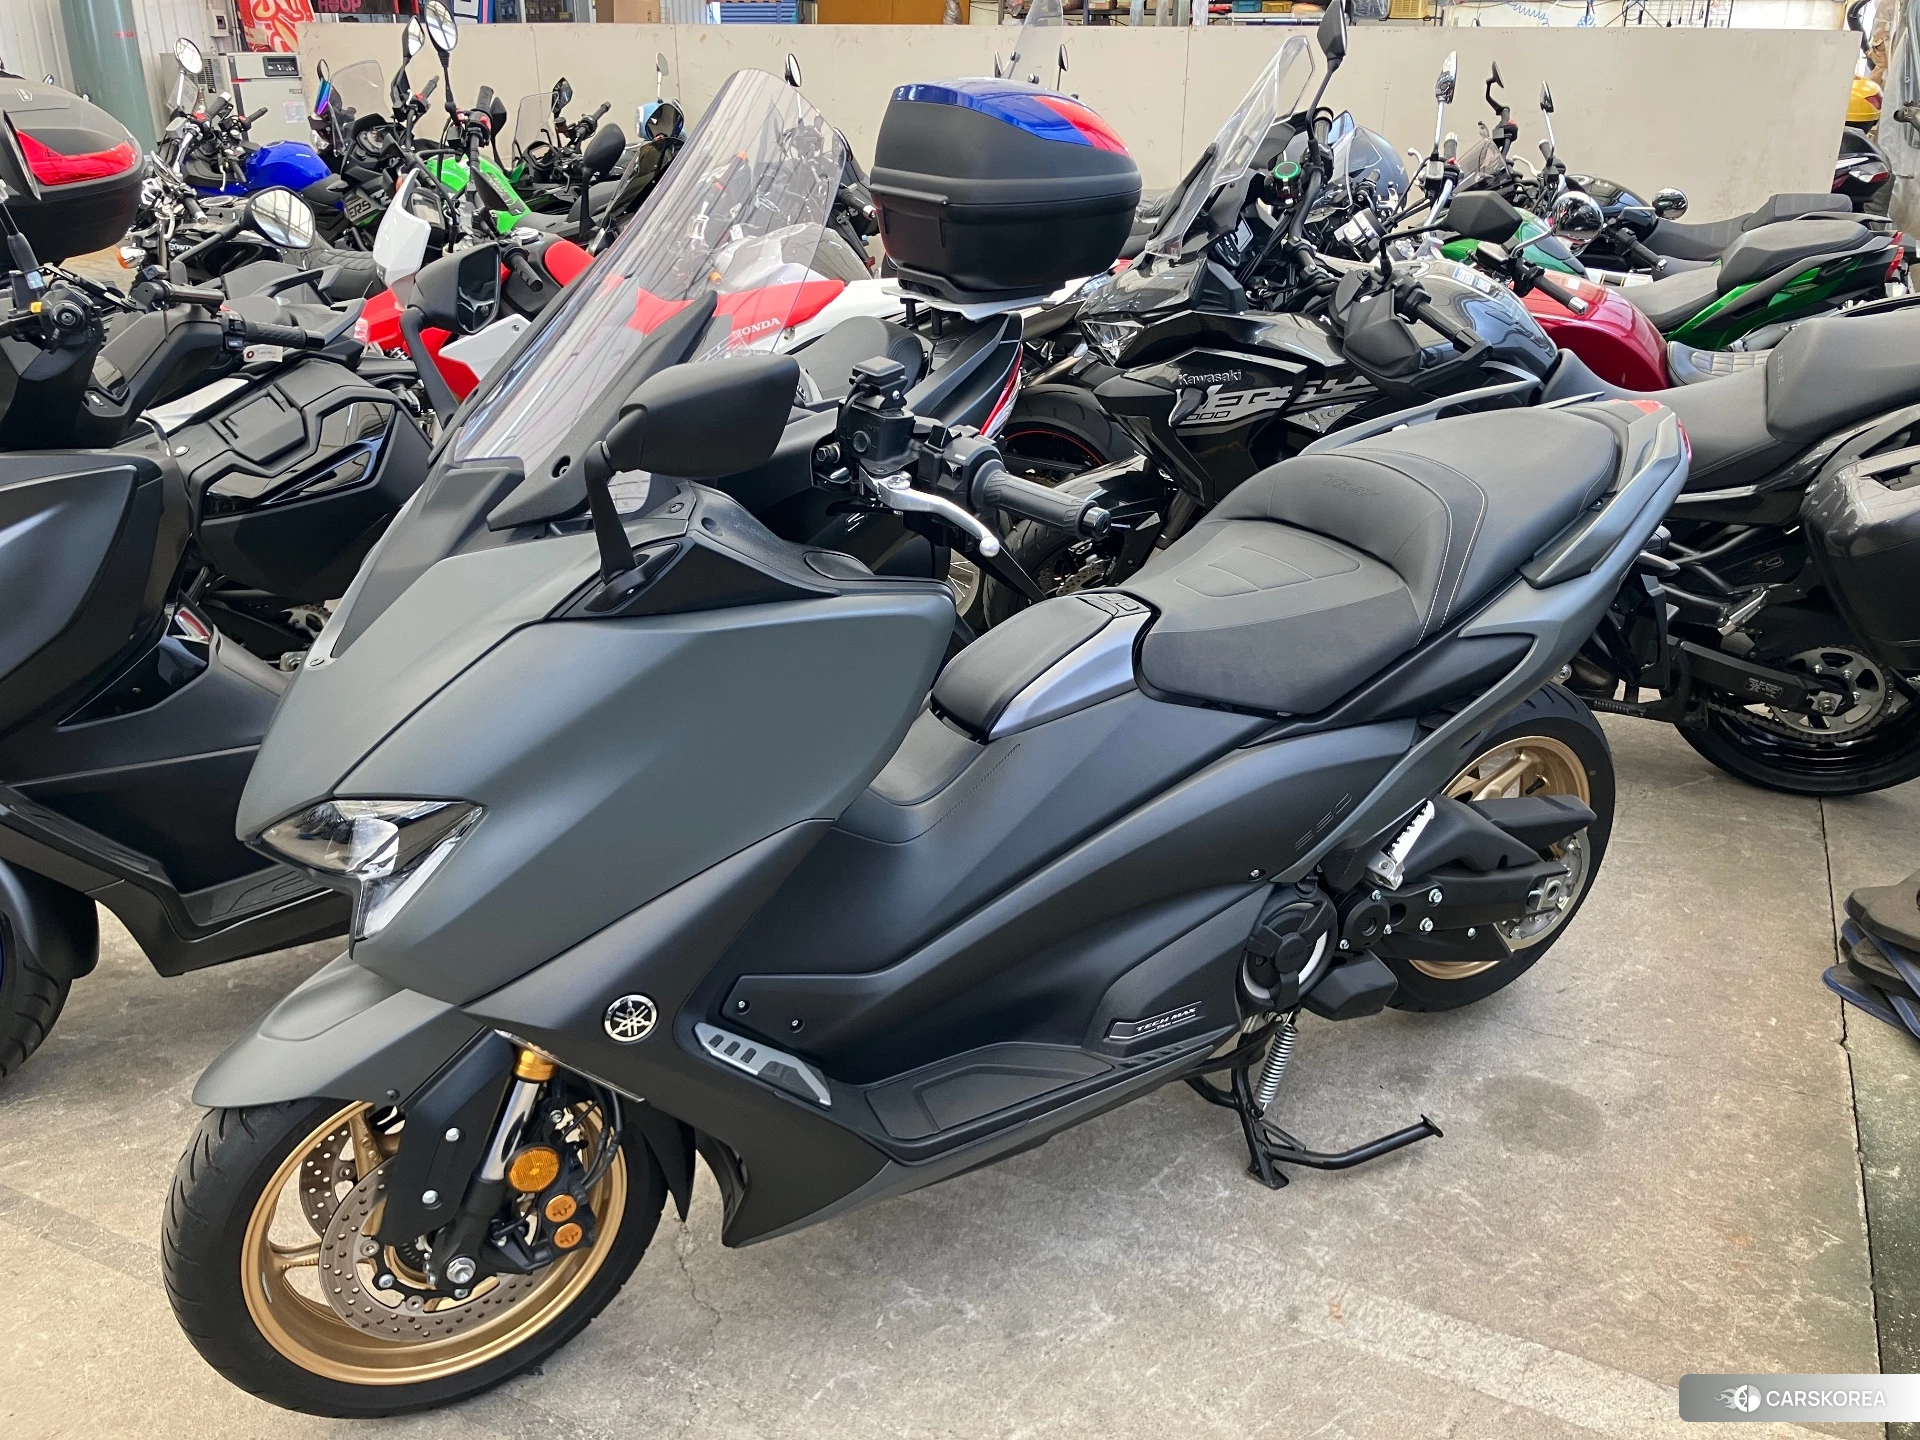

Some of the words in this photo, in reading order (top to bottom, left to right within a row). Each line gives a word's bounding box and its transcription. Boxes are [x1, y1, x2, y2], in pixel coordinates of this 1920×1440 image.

[731, 317, 781, 337] HONDA
[1178, 369, 1242, 385] Kawasaki
[1136, 1016, 1170, 1032] TECH
[1170, 1007, 1197, 1020] MAX
